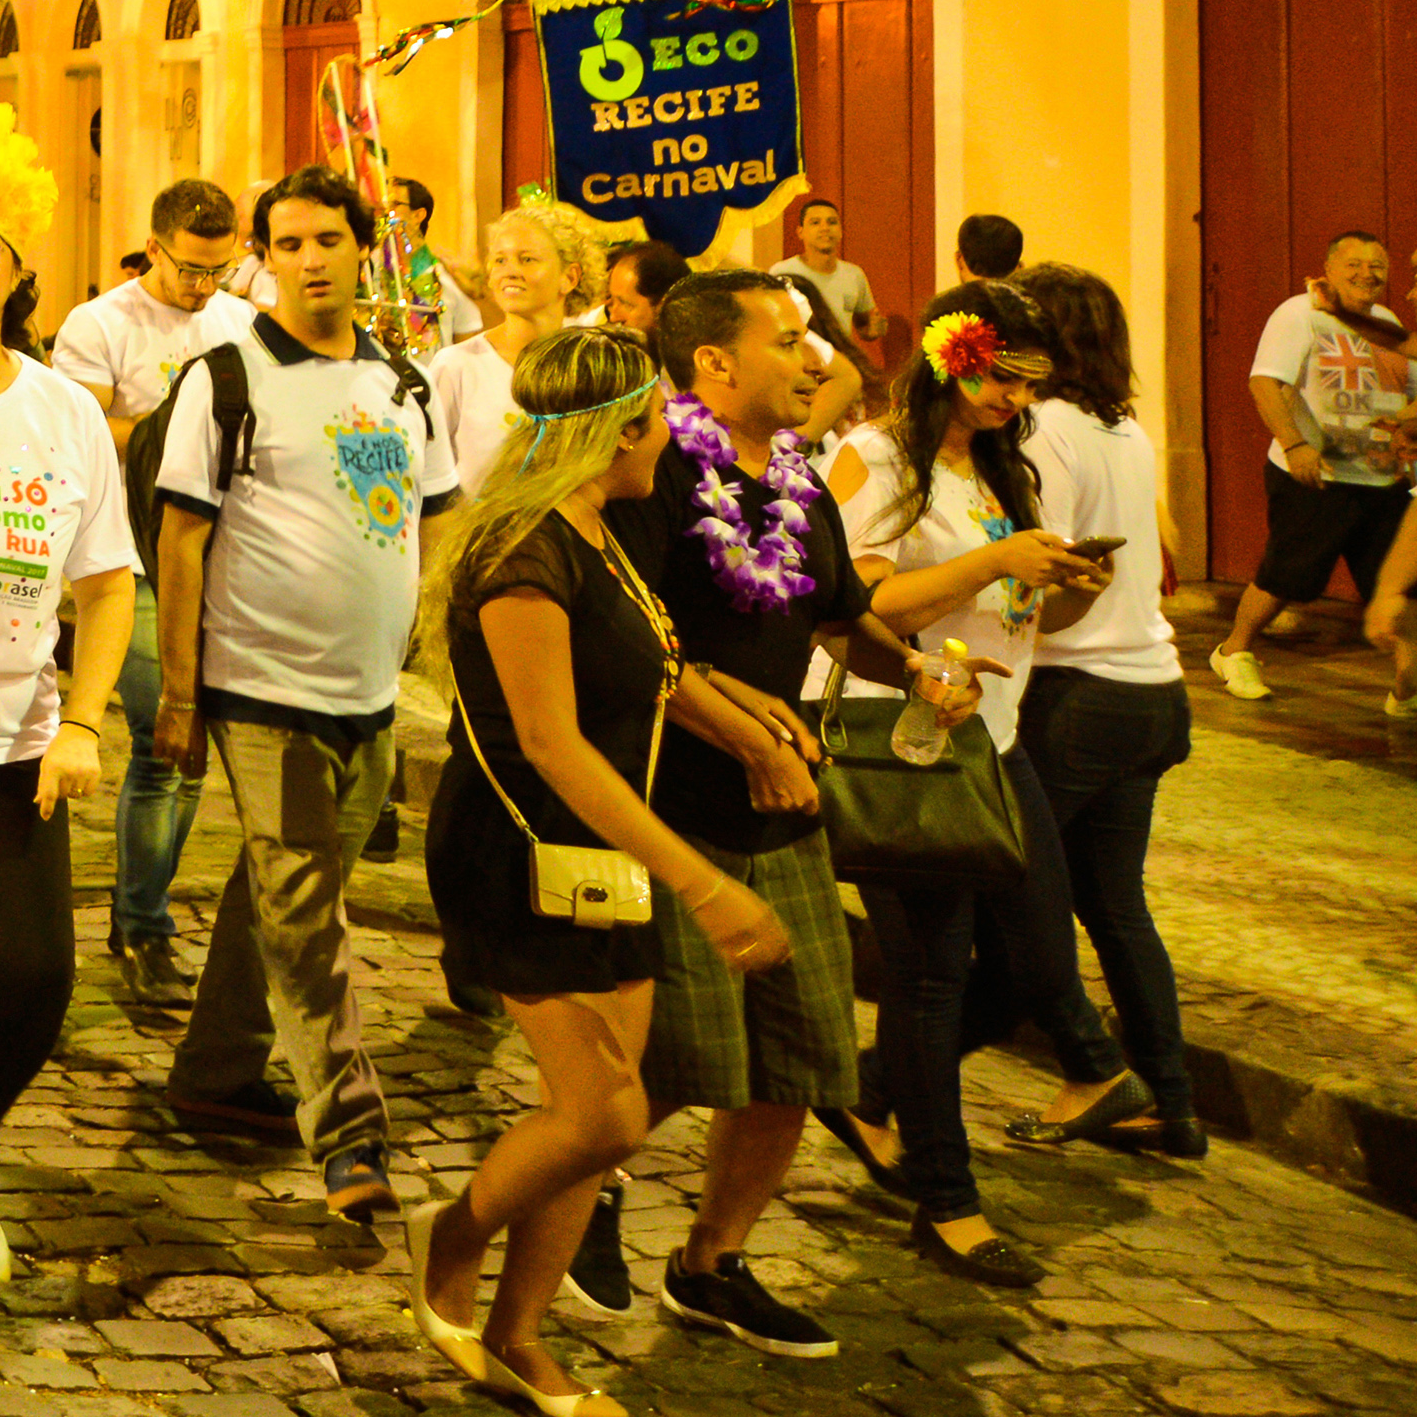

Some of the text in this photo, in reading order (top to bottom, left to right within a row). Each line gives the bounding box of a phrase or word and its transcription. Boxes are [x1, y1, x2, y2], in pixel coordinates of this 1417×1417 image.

[650, 28, 760, 72] ECO
[589, 80, 762, 133] RECIFE
[652, 133, 709, 167] no
[580, 148, 777, 205] Carnaval
[11, 476, 49, 507] SÓ
[5, 531, 51, 558] RUA
